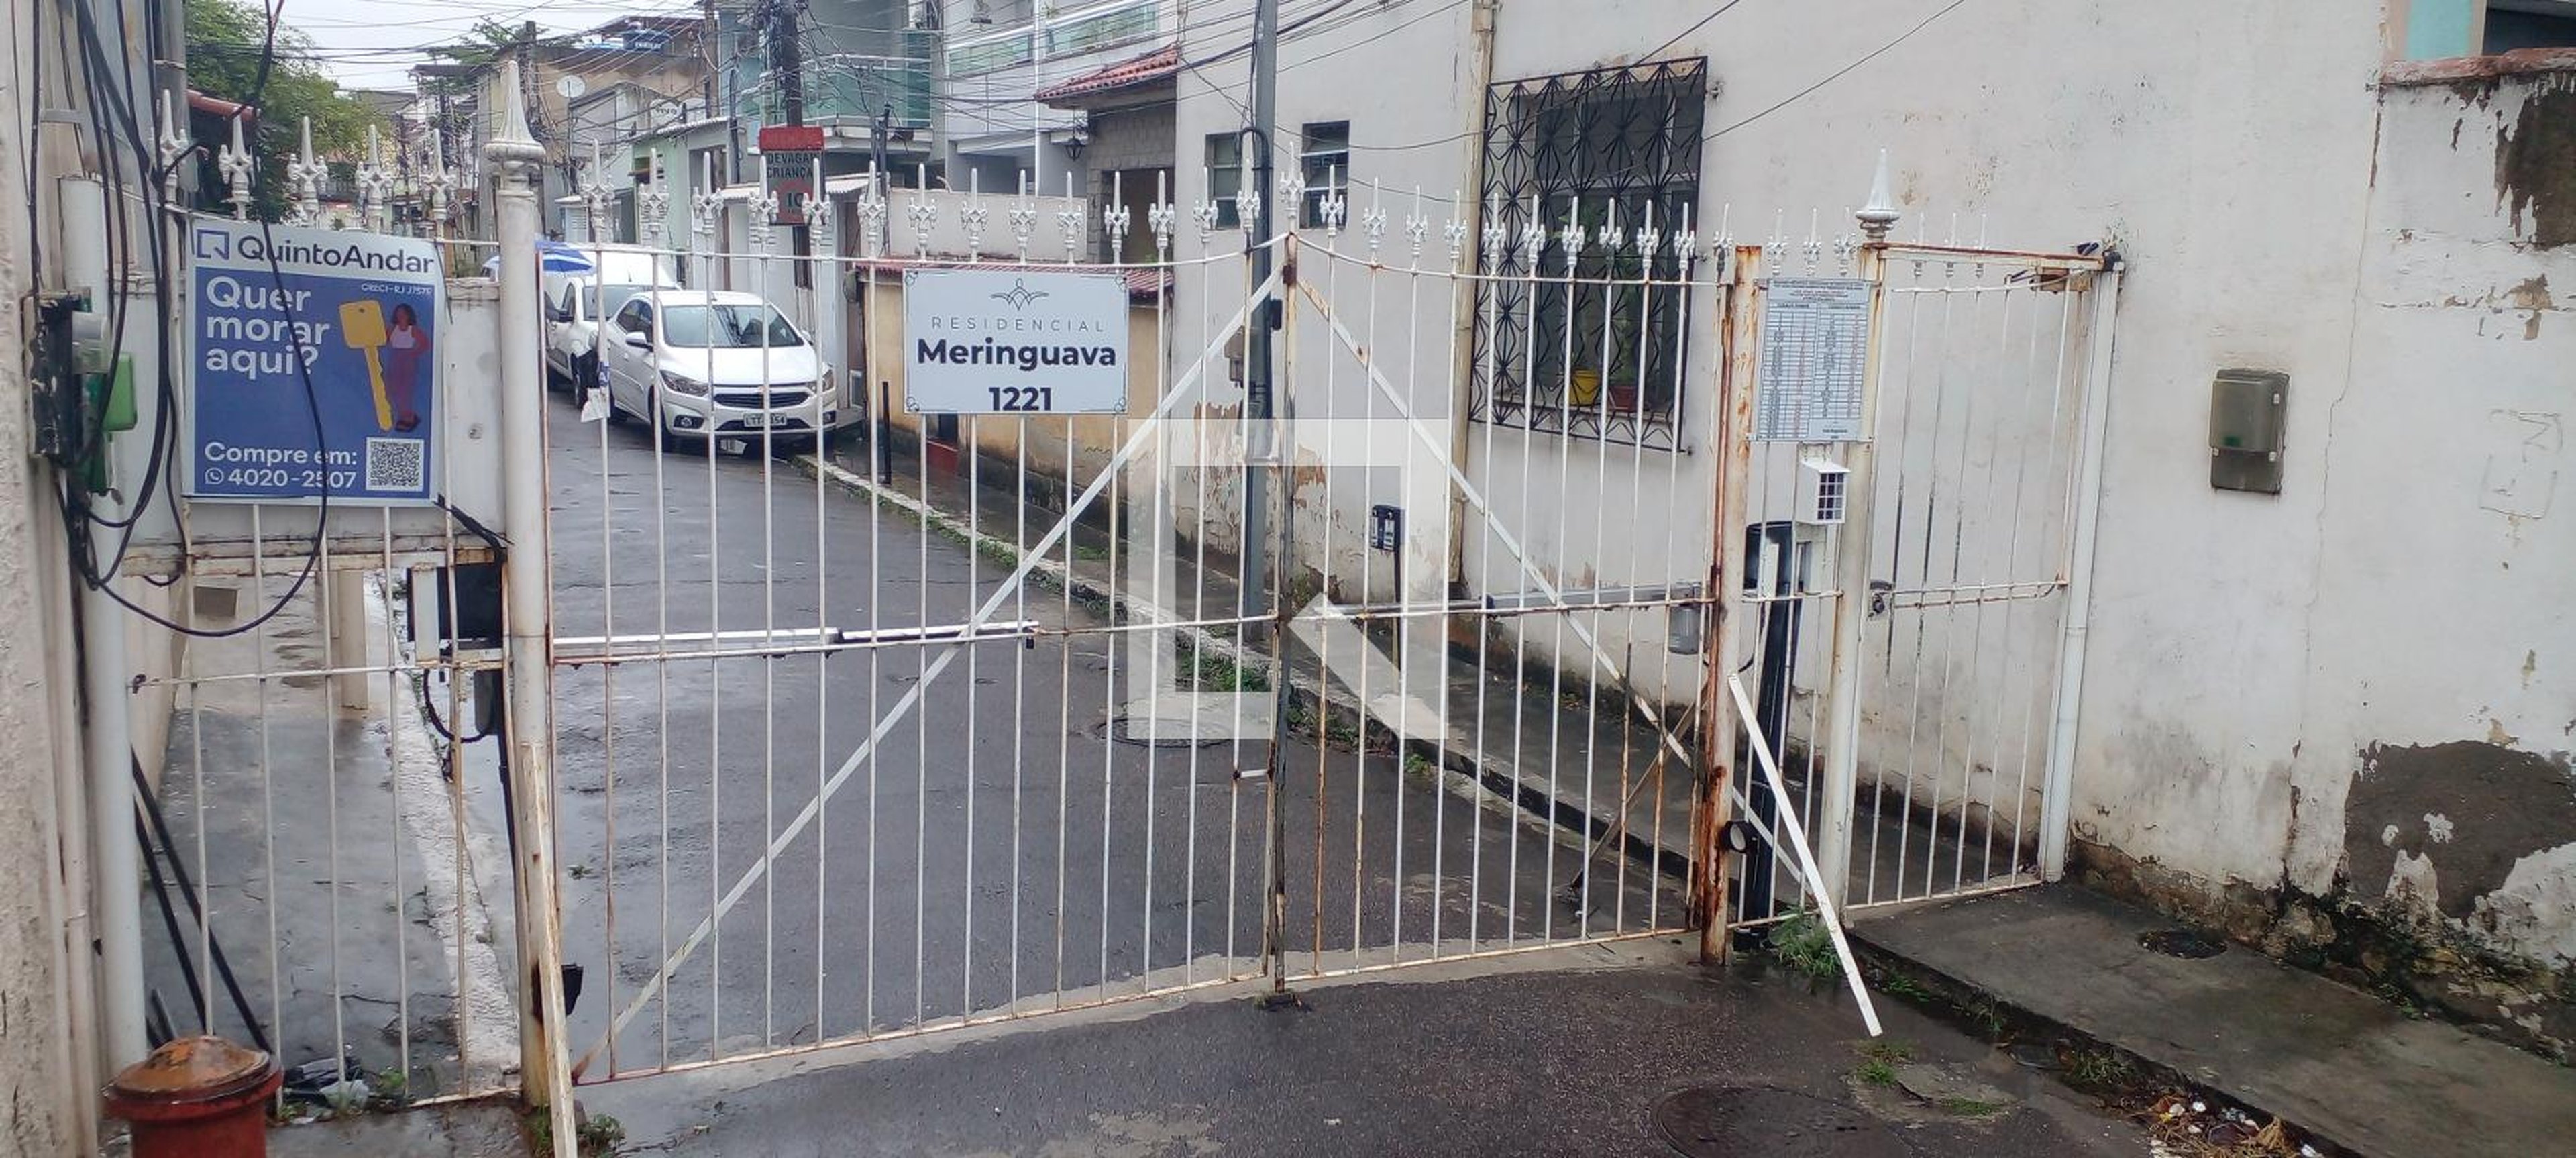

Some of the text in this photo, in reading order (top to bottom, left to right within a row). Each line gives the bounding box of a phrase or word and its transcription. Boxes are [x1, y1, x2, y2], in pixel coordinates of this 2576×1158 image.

[237, 235, 435, 273] QuintoAndar
[206, 276, 311, 311] Quer
[207, 316, 331, 345] morar
[932, 316, 1104, 333] RESIDENCIAL
[206, 345, 319, 380] aqui?
[918, 337, 1116, 371] Meringuava
[989, 387, 1051, 411] 1221
[205, 442, 357, 466] Compre em:
[228, 468, 357, 488] 4020-2507
